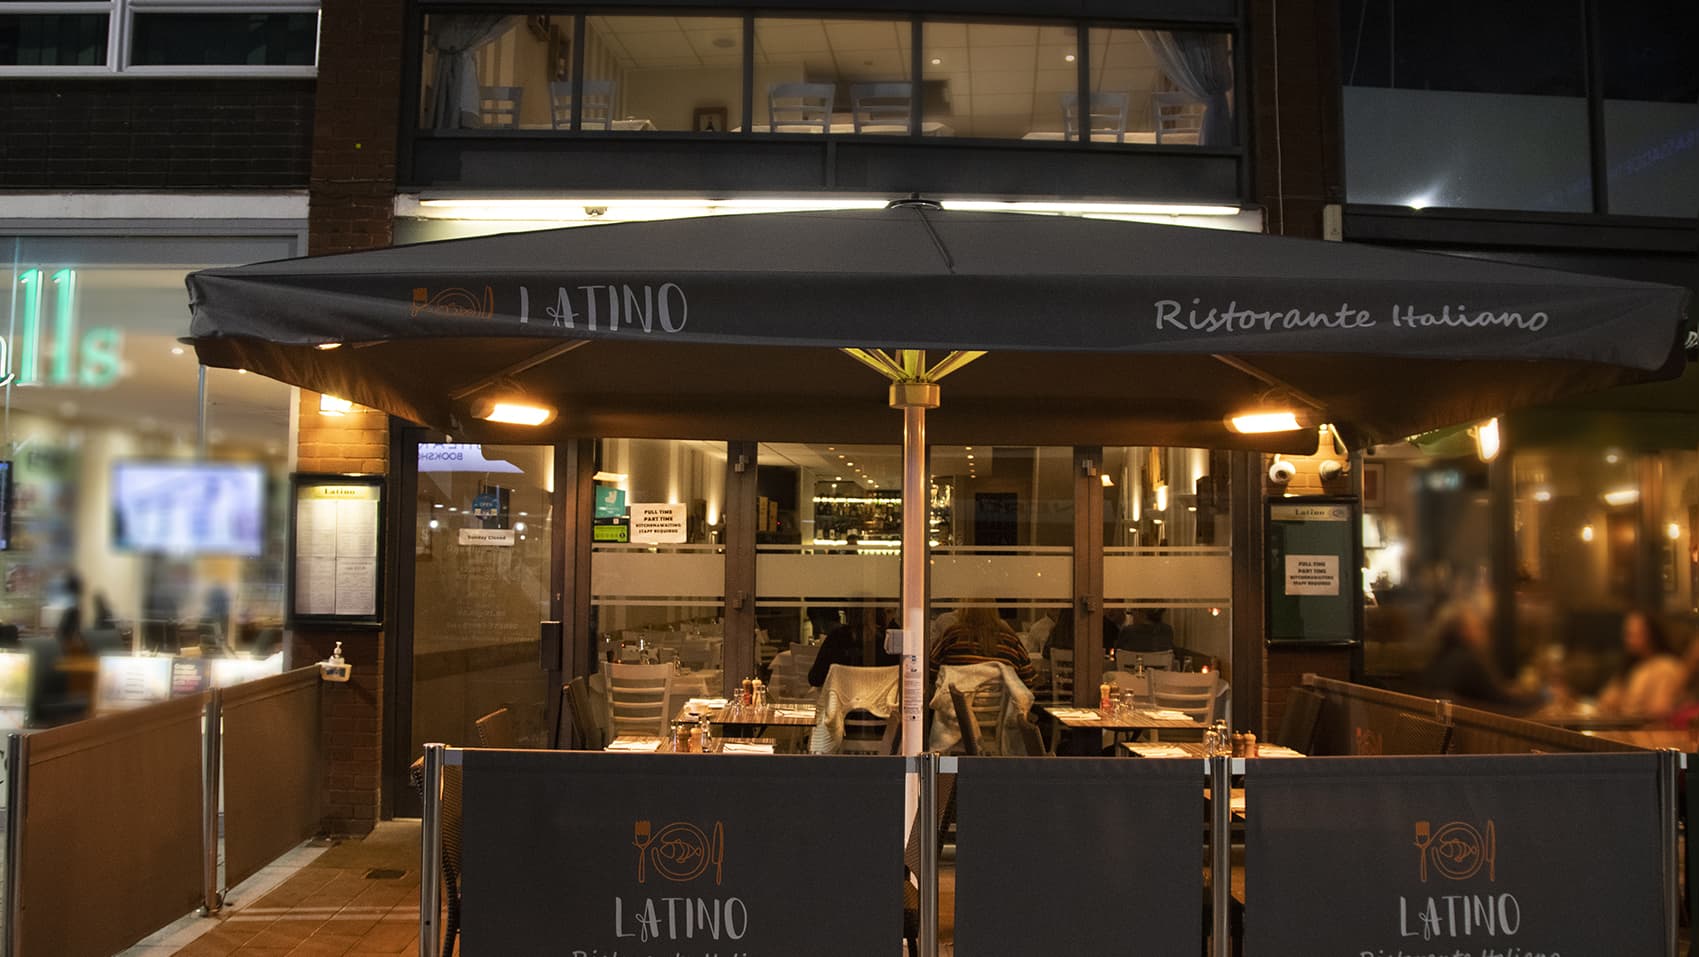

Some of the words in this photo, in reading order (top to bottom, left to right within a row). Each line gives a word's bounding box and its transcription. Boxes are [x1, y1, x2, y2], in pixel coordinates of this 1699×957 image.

[0, 267, 121, 388] lls
[520, 283, 688, 332] LATINO
[1154, 298, 1376, 332] Ristorante
[1392, 304, 1548, 331] Italiano
[324, 487, 355, 495] Latino
[1295, 508, 1325, 516] Latino
[615, 897, 748, 942] LATINO
[1400, 893, 1521, 941] LATINO
